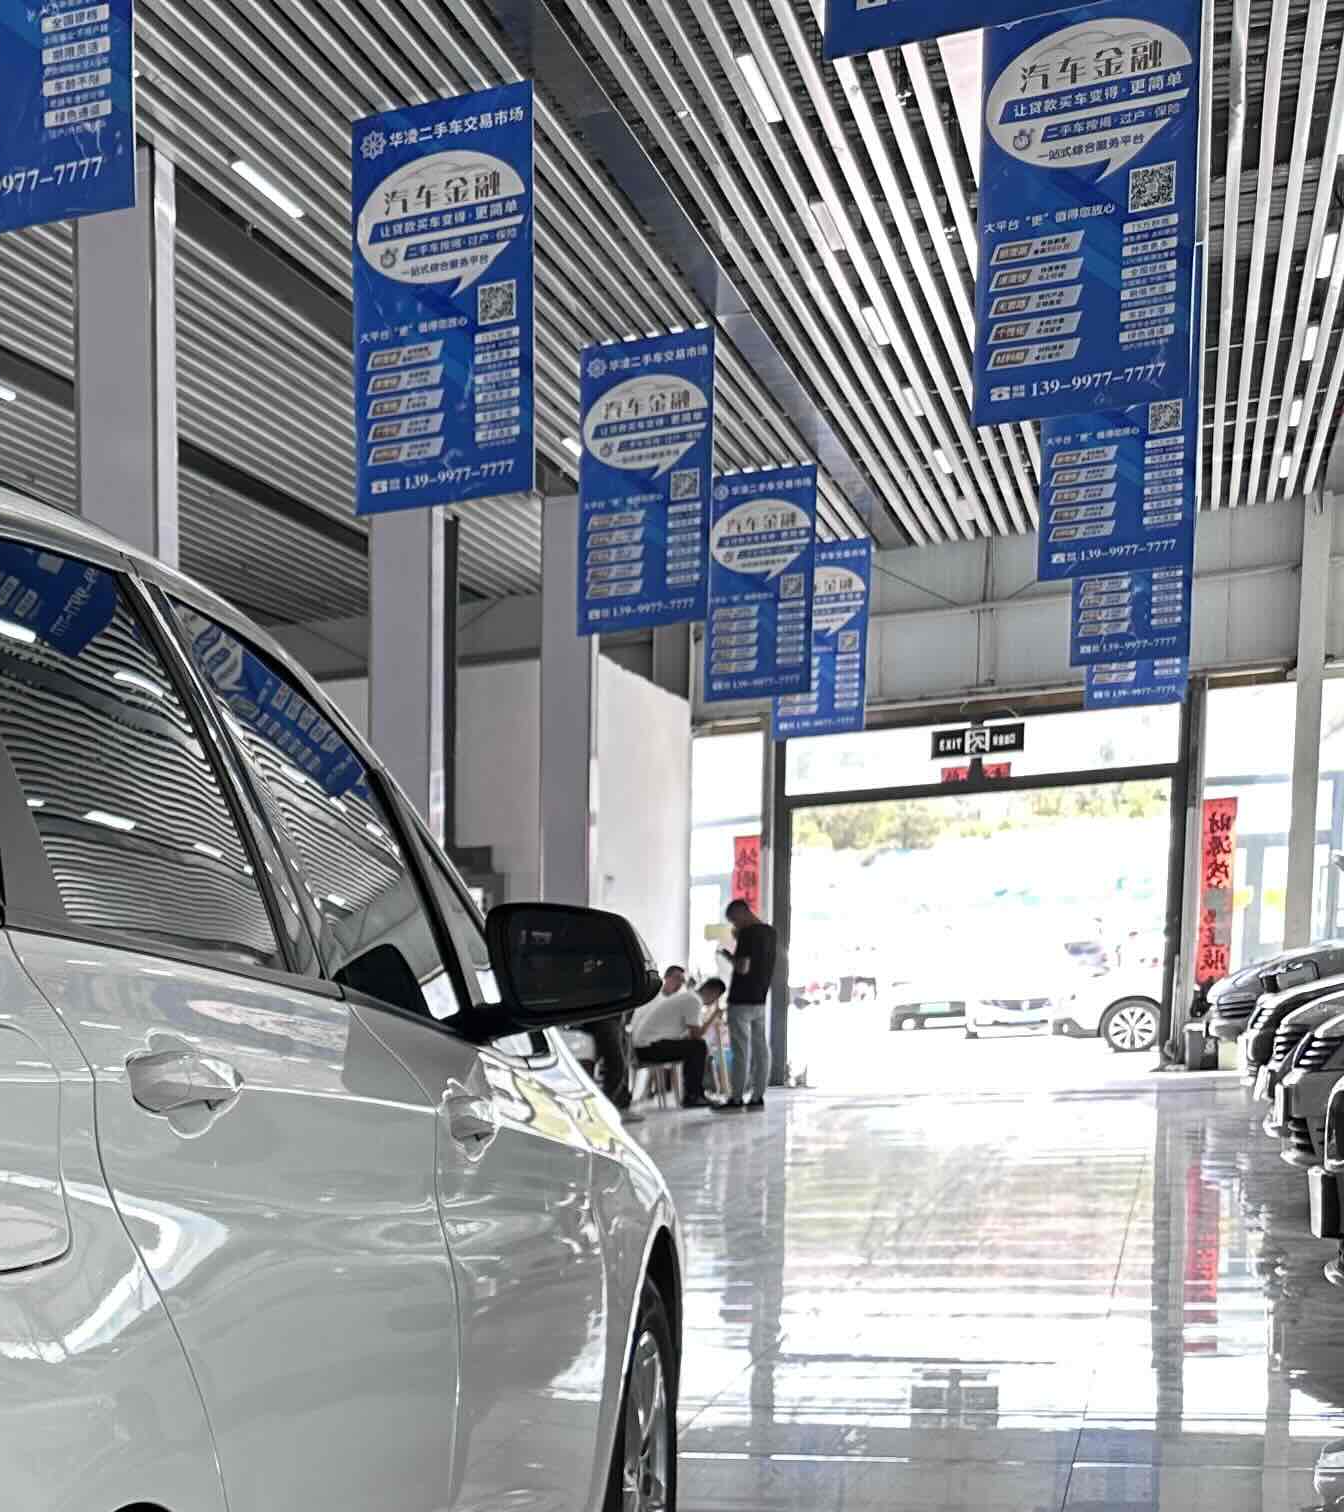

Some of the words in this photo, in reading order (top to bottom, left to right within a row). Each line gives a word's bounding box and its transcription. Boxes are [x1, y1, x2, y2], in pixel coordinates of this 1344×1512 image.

[1019, 40, 1162, 93] 汽车金融
[389, 106, 524, 147] 华凌二手车交易市场
[383, 169, 500, 215] 汽车金融
[1031, 363, 1166, 397] 139-9977-7777
[601, 390, 690, 419] 汽车金融
[404, 459, 514, 490] 139-9977-7777
[1080, 539, 1176, 561] 139-9977-7777
[939, 737, 962, 752] EXIT
